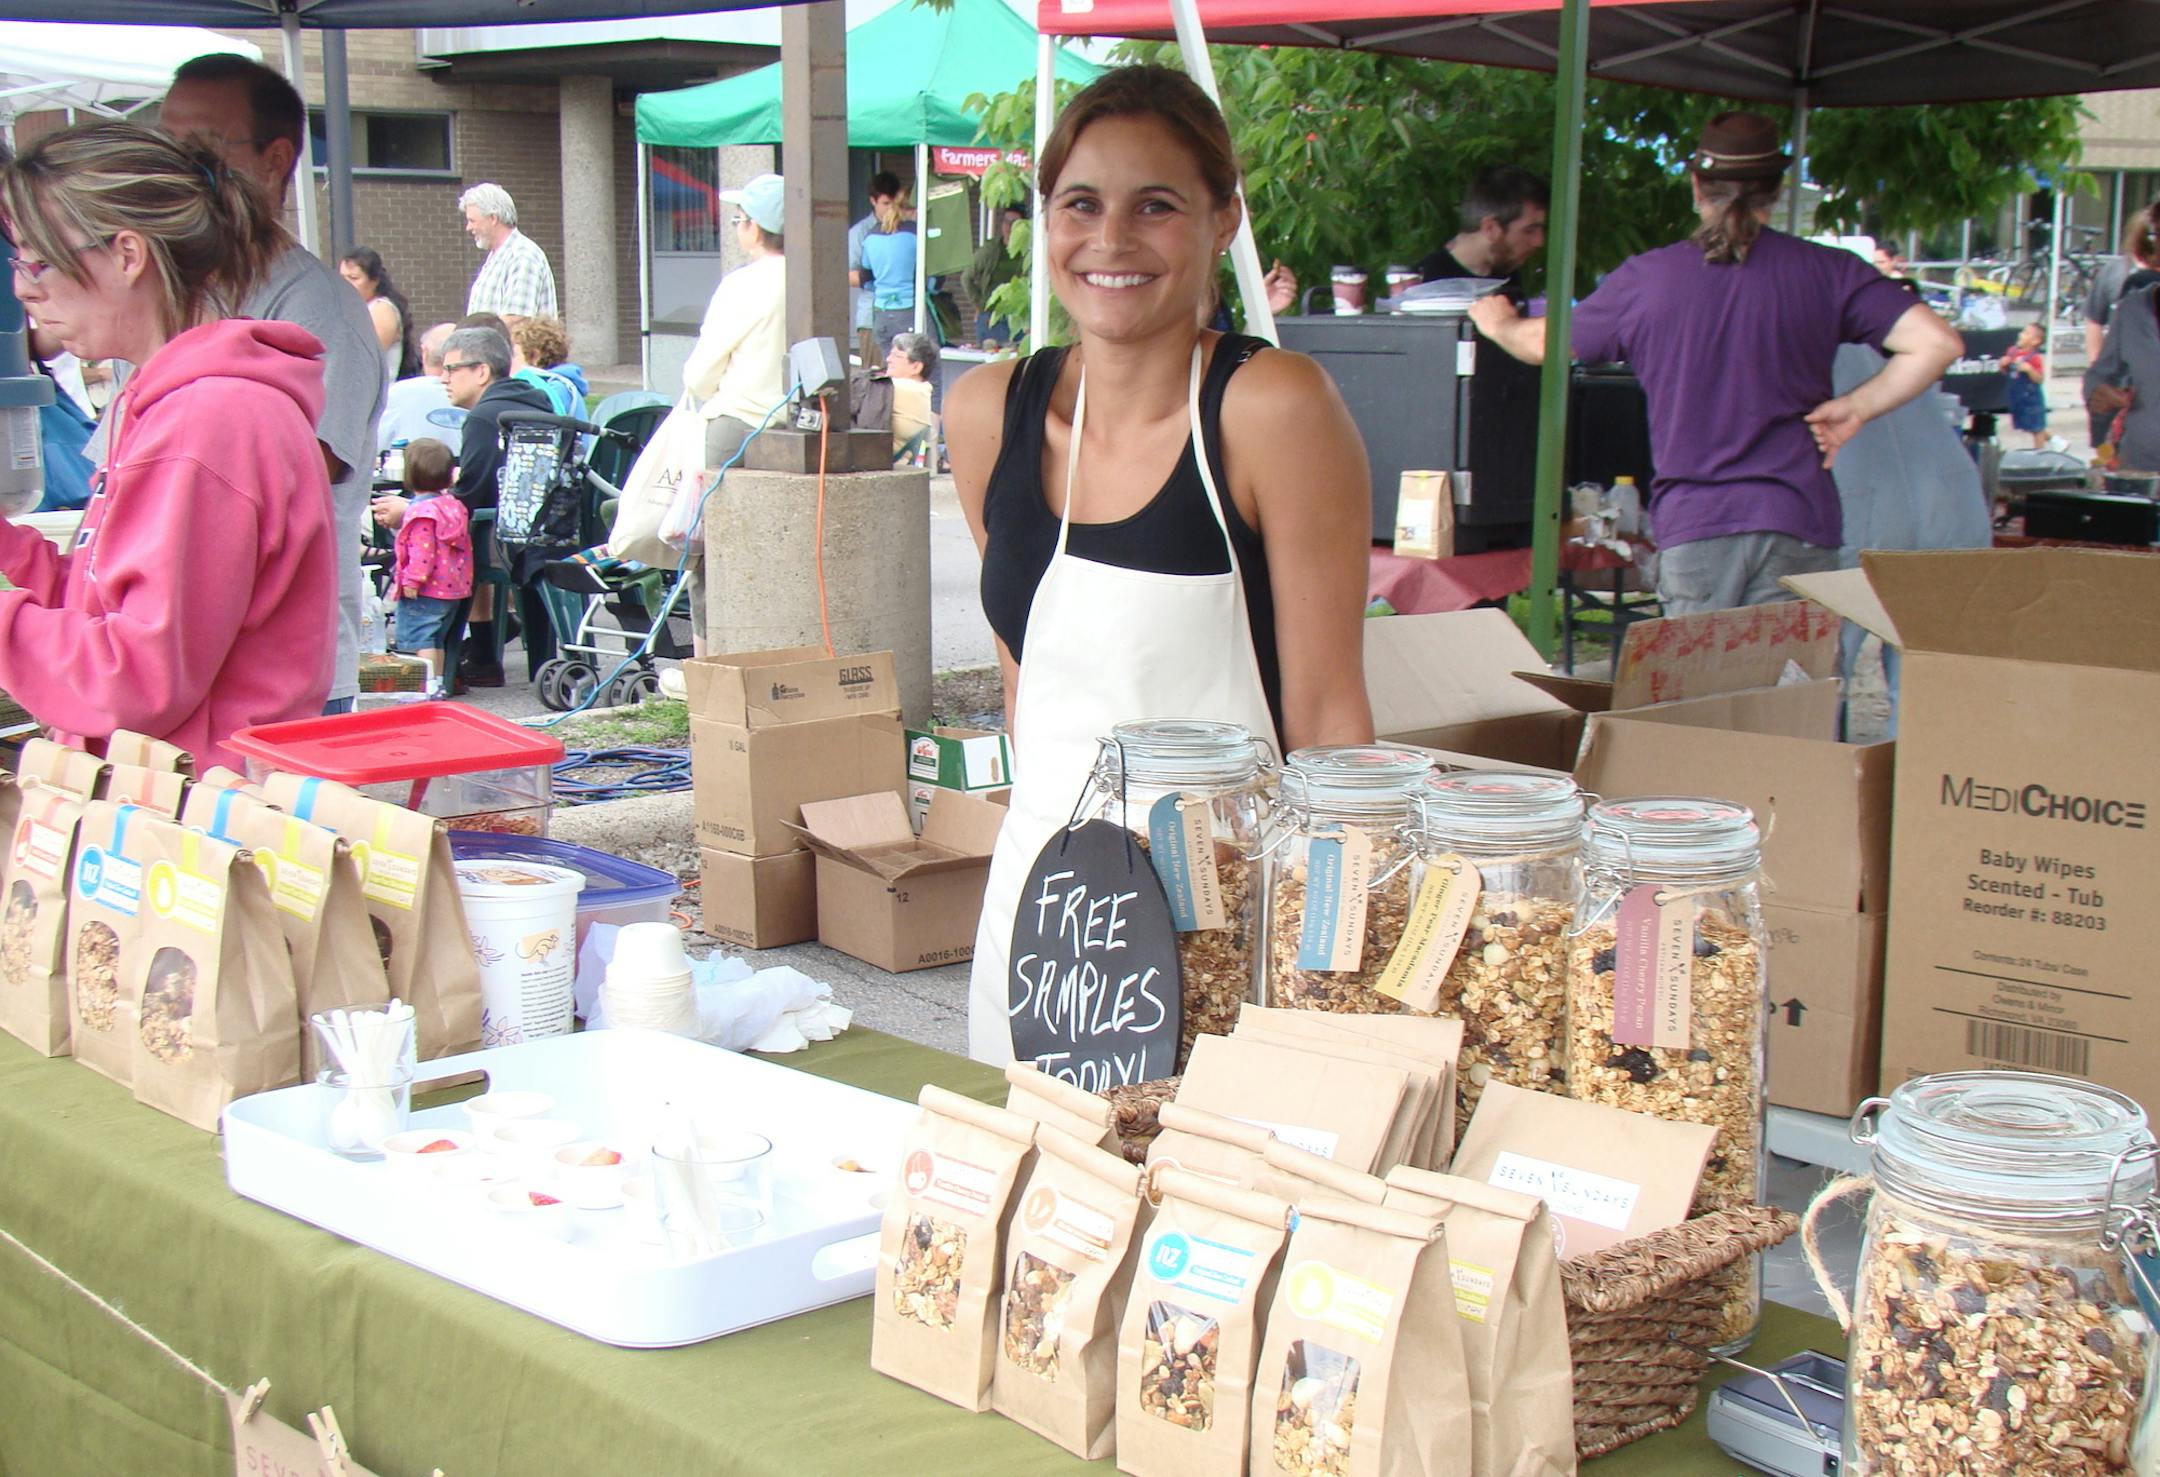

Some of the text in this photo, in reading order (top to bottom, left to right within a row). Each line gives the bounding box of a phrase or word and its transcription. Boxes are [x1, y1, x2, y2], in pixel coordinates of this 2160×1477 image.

[941, 148, 998, 167] Farmers
[840, 666, 872, 682] GLASS
[1166, 820, 1180, 857] Original
[1175, 883, 1188, 918] Zealand
[1193, 818, 1213, 915] SEVEN SUNDAYS
[1322, 853, 1336, 893] Original
[1349, 854, 1362, 891] SEVEN
[1979, 849, 2096, 880] Baby Wipes
[896, 893, 909, 903] 12
[1430, 877, 1451, 910] Ginger
[1967, 873, 2045, 899] Scented
[2067, 887, 2104, 908] Tub
[1034, 870, 1138, 958] FREE
[1343, 904, 1357, 956] SUNDAYS
[1421, 911, 1438, 936] Pear
[1962, 898, 2025, 919] Reorder
[2051, 911, 2106, 931] 88203
[1317, 919, 1330, 956] Zealand
[1395, 935, 1428, 990] Macadamia
[1633, 917, 1651, 1029] Vanilla Cherry Pecan
[1666, 919, 1683, 1031] SEVEN SUNDAYS
[1008, 953, 1166, 1042] SAMPLES
